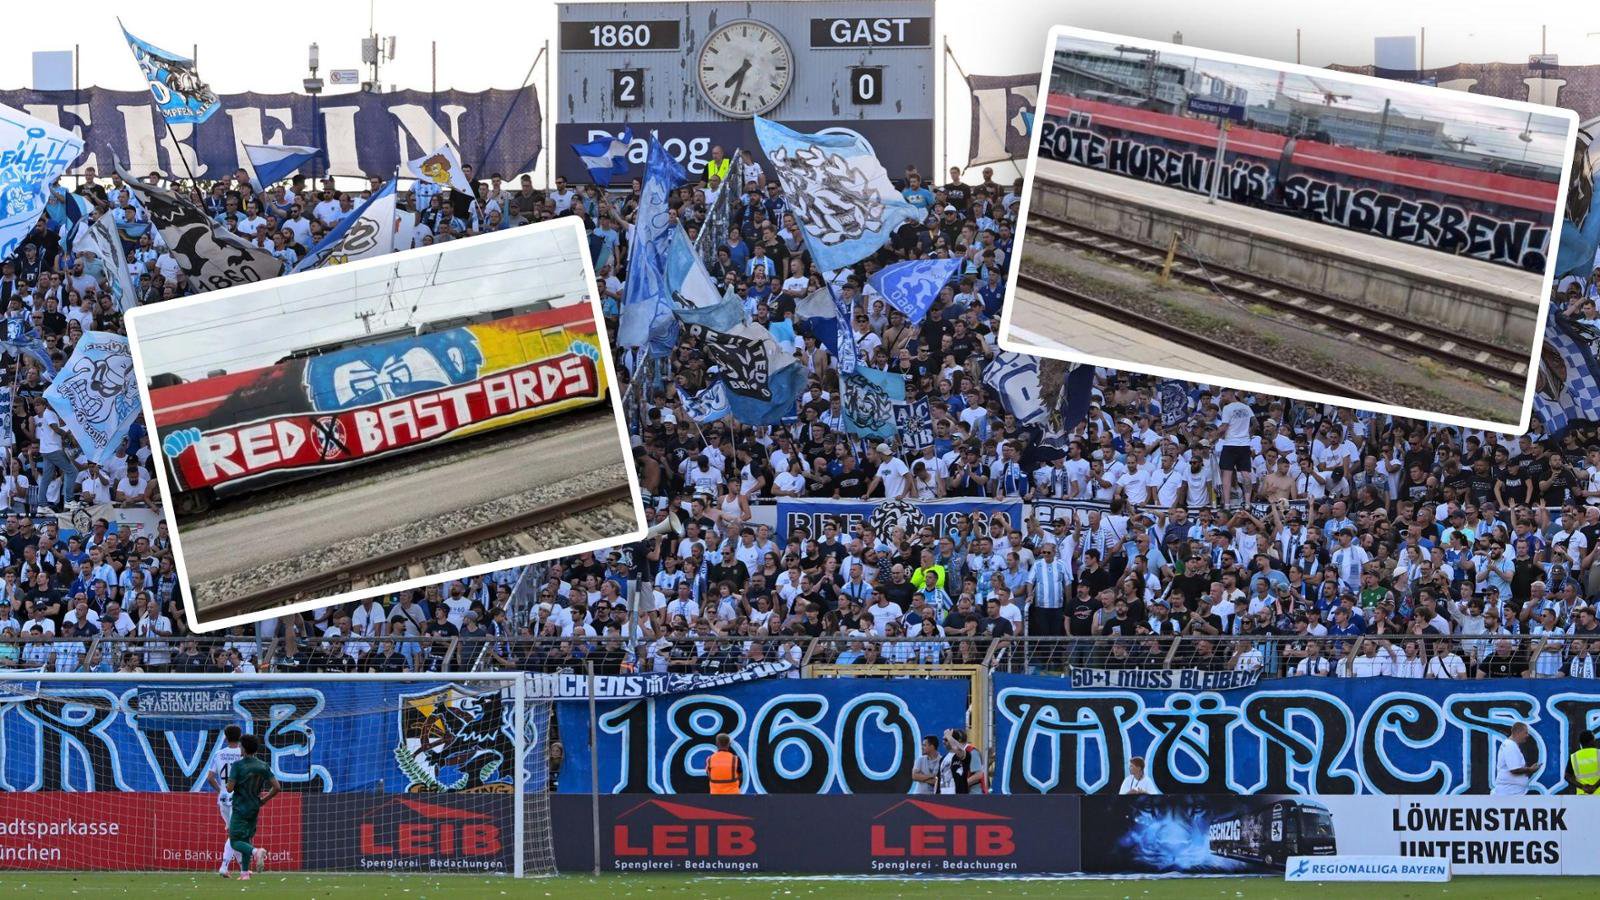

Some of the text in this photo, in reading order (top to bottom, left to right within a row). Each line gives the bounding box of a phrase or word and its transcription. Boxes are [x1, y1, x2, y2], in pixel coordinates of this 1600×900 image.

[590, 25, 650, 47] 1860
[830, 18, 911, 43] GAST
[620, 76, 635, 101] 2
[859, 74, 874, 100] 0
[1108, 138, 1206, 192] HUREN
[199, 419, 306, 481] RED
[354, 356, 590, 452] BASTARDS
[1072, 668, 1262, 691] 50+1 MUSS BLEIBEN!
[139, 700, 232, 712] STADIONVERBOT
[160, 691, 210, 702] SEKTION
[598, 692, 921, 794] 1860
[0, 818, 119, 839] adtsparkasse
[1392, 803, 1568, 831] LÖWENSTARK
[359, 823, 502, 855] LEIB
[614, 825, 757, 856] LEIB
[871, 825, 1015, 856] LEIB
[1209, 819, 1241, 841] SECHZIG
[163, 849, 181, 860] Die
[184, 849, 212, 860] Bank
[360, 858, 418, 868] Spenglerei
[430, 858, 503, 869] Bedachungen
[1400, 840, 1560, 864] UNTERWEGS
[615, 860, 673, 871] Spenglerei
[685, 860, 759, 871] Bedachungen
[871, 860, 930, 871] Spenglerei
[943, 860, 1017, 871] Bedachungen
[1312, 864, 1446, 875] REGIONALLIGA BAYERN
